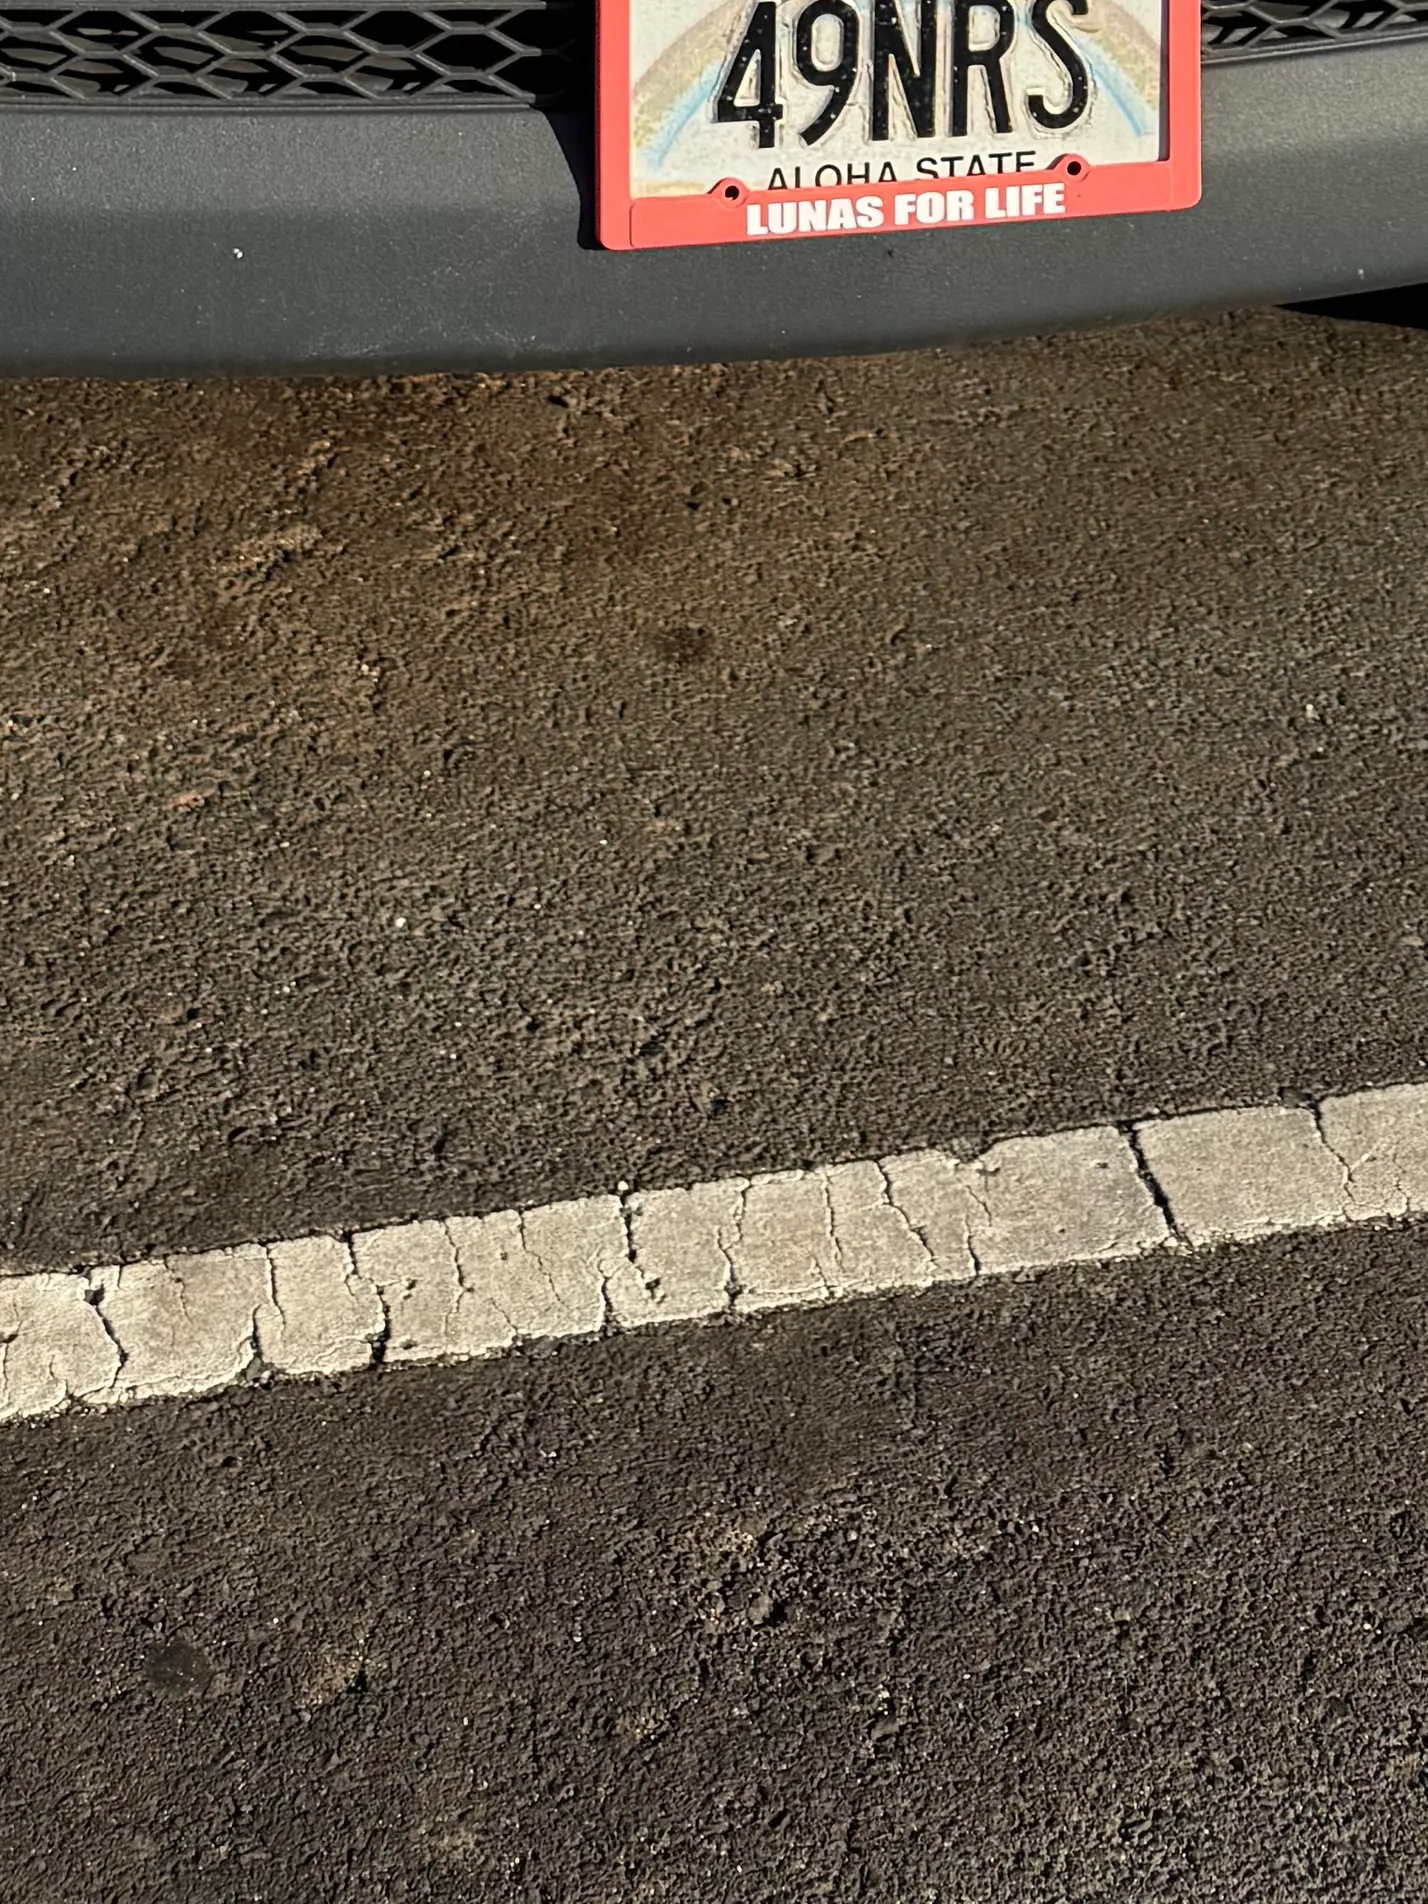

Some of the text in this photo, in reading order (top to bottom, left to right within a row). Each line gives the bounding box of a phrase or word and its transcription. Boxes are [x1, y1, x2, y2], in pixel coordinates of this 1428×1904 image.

[767, 149, 1037, 191] ALOHA STATE
[747, 182, 1066, 236] LUNAS FOR LIFE
